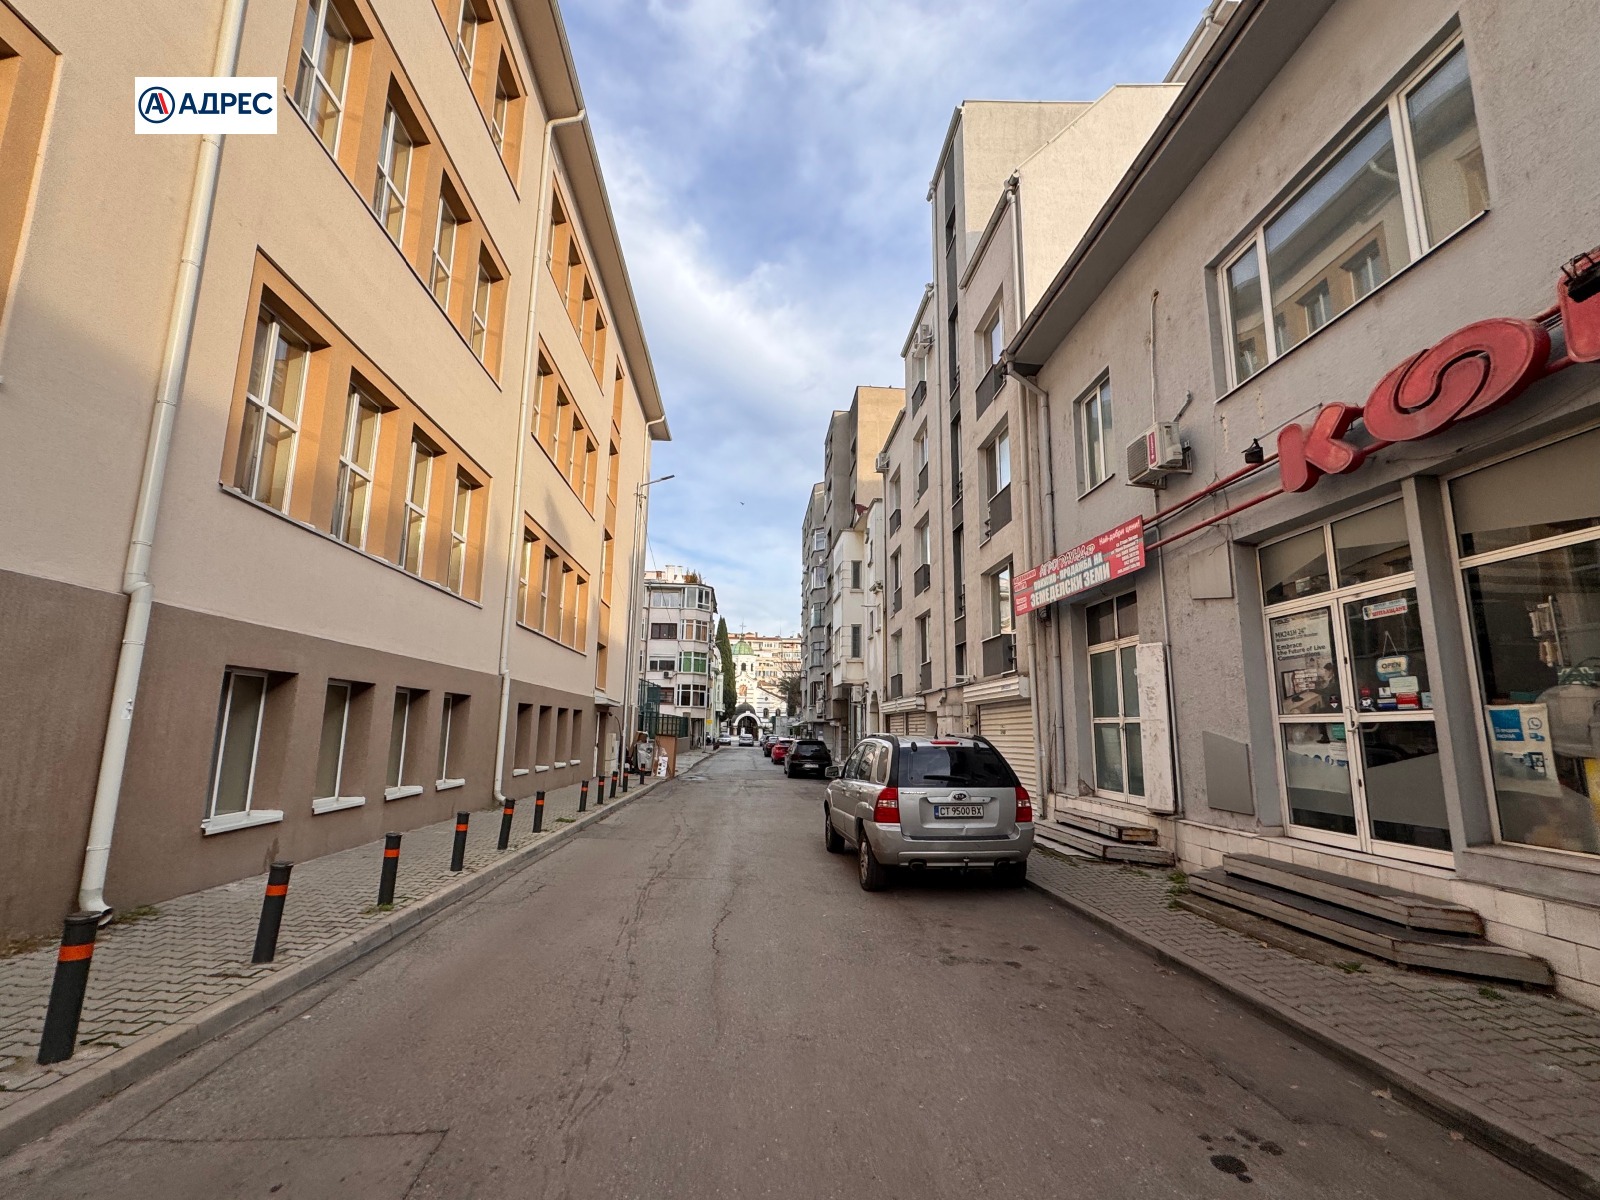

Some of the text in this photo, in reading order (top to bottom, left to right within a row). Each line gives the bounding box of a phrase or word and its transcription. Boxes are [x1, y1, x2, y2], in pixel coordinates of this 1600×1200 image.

[1059, 557, 1092, 580] ПРОДАЖБА
[1093, 552, 1103, 565] НА
[1030, 573, 1083, 608] ЗЕМЕДЕЛСКИ
[1083, 562, 1111, 587] ЗЕМИ
[1276, 642, 1302, 651] Embrace
[1288, 647, 1305, 655] Future
[1381, 661, 1402, 670] OPEN
[940, 806, 982, 816] CT 9500 BX
